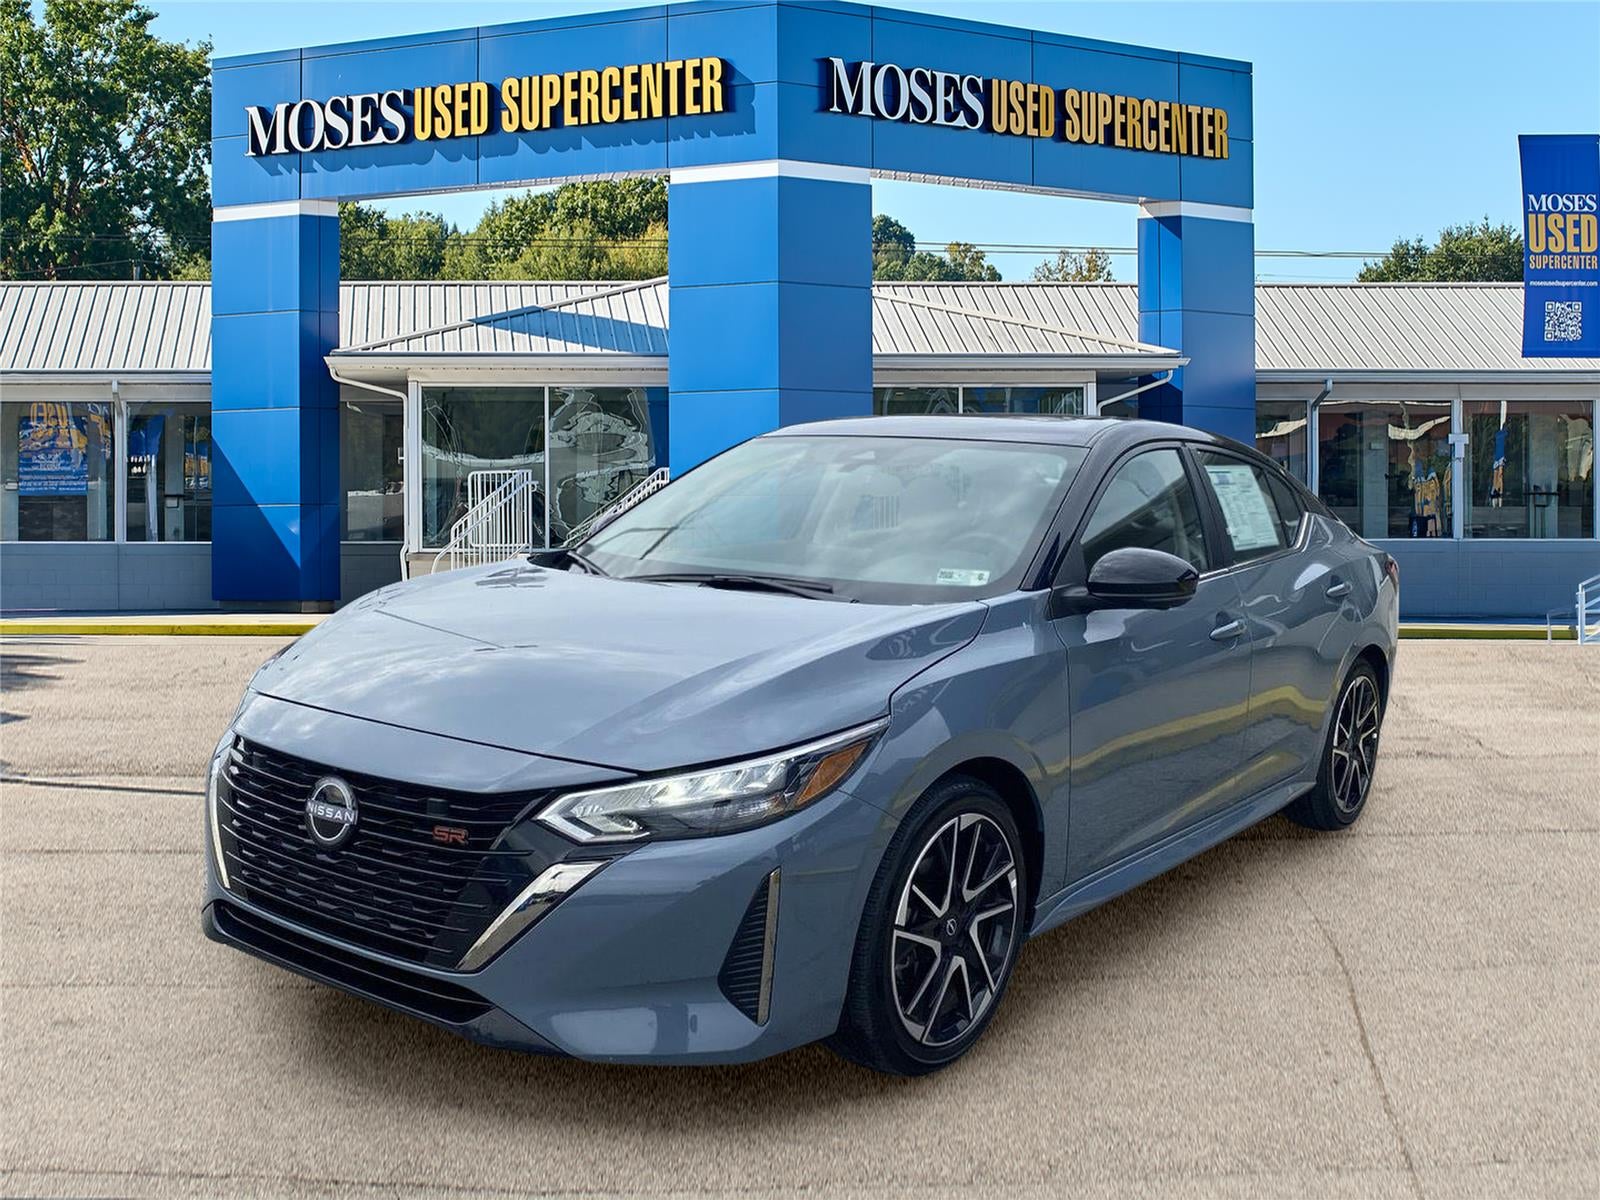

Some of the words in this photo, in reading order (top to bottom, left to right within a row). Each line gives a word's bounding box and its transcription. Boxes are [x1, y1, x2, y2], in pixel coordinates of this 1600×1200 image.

[244, 89, 408, 157] MOSES
[413, 81, 489, 141] USED
[501, 57, 724, 133] SUPERCENTER
[828, 57, 984, 130] MOSES
[991, 78, 1055, 138] USED
[1065, 88, 1229, 159] SUPERCENTER
[1527, 194, 1597, 212] MOSES
[1527, 214, 1598, 253] USED
[1529, 255, 1598, 270] SUPERCENTER
[306, 801, 356, 822] NISSAN
[432, 825, 468, 844] SR
